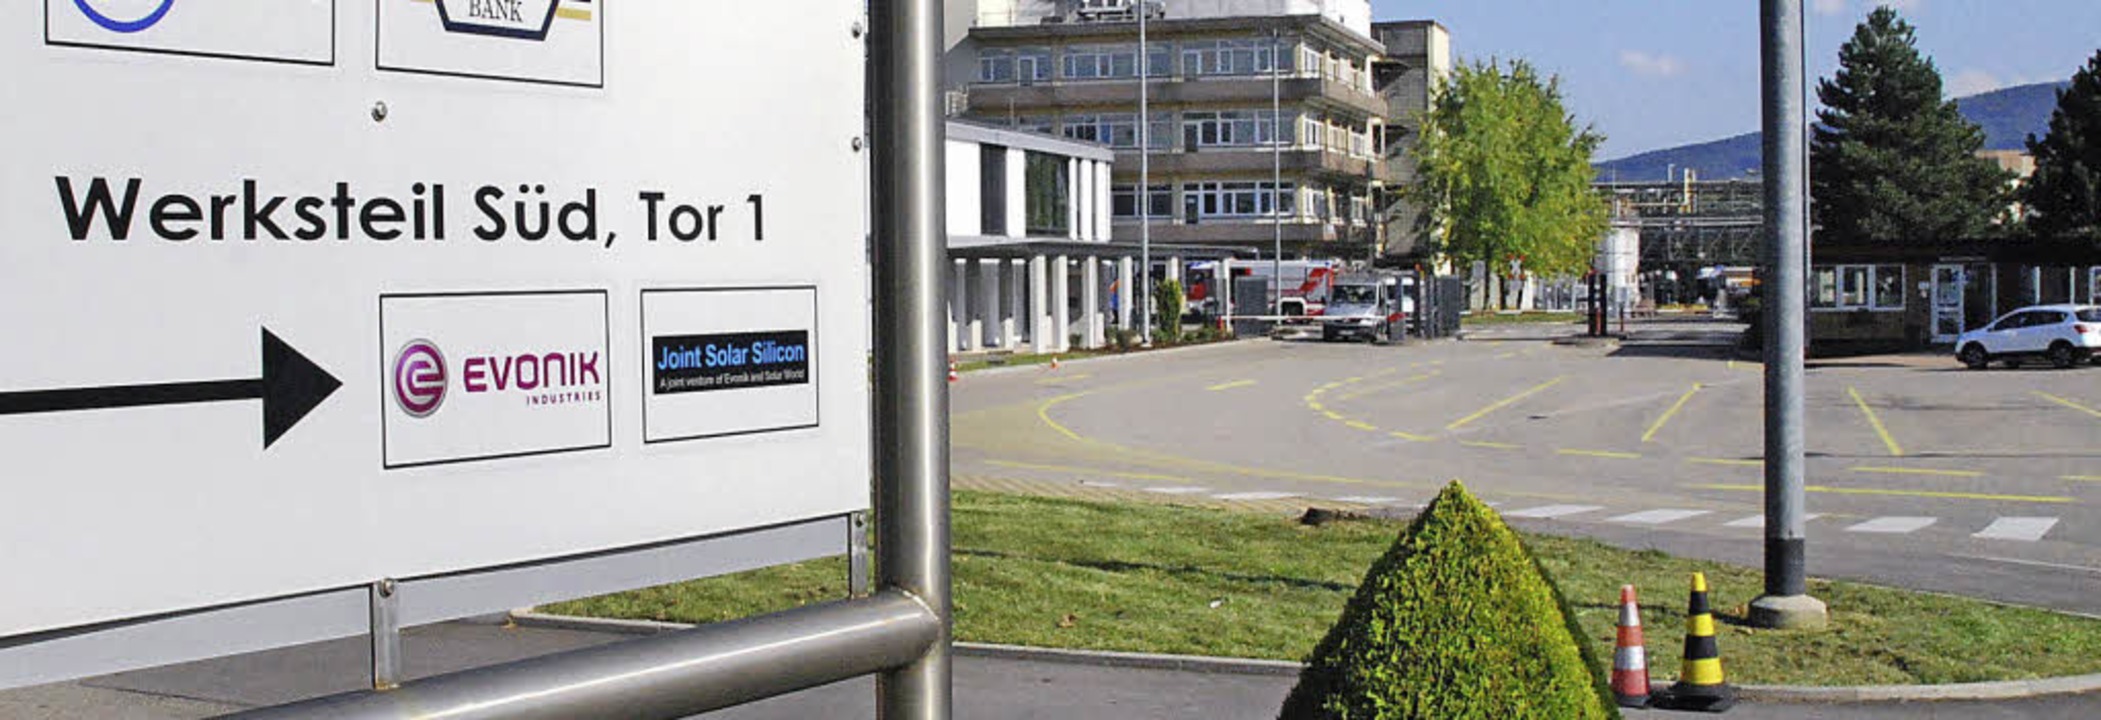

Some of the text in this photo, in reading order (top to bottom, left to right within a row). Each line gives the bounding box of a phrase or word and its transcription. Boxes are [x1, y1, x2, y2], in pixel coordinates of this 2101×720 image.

[469, 0, 523, 23] BANK
[54, 175, 763, 249] Werksteil Süd, Tor 1
[657, 341, 804, 370] Joint Solar Silicon
[463, 351, 600, 392] EVONIK
[526, 391, 601, 405] INDUSTRIES
